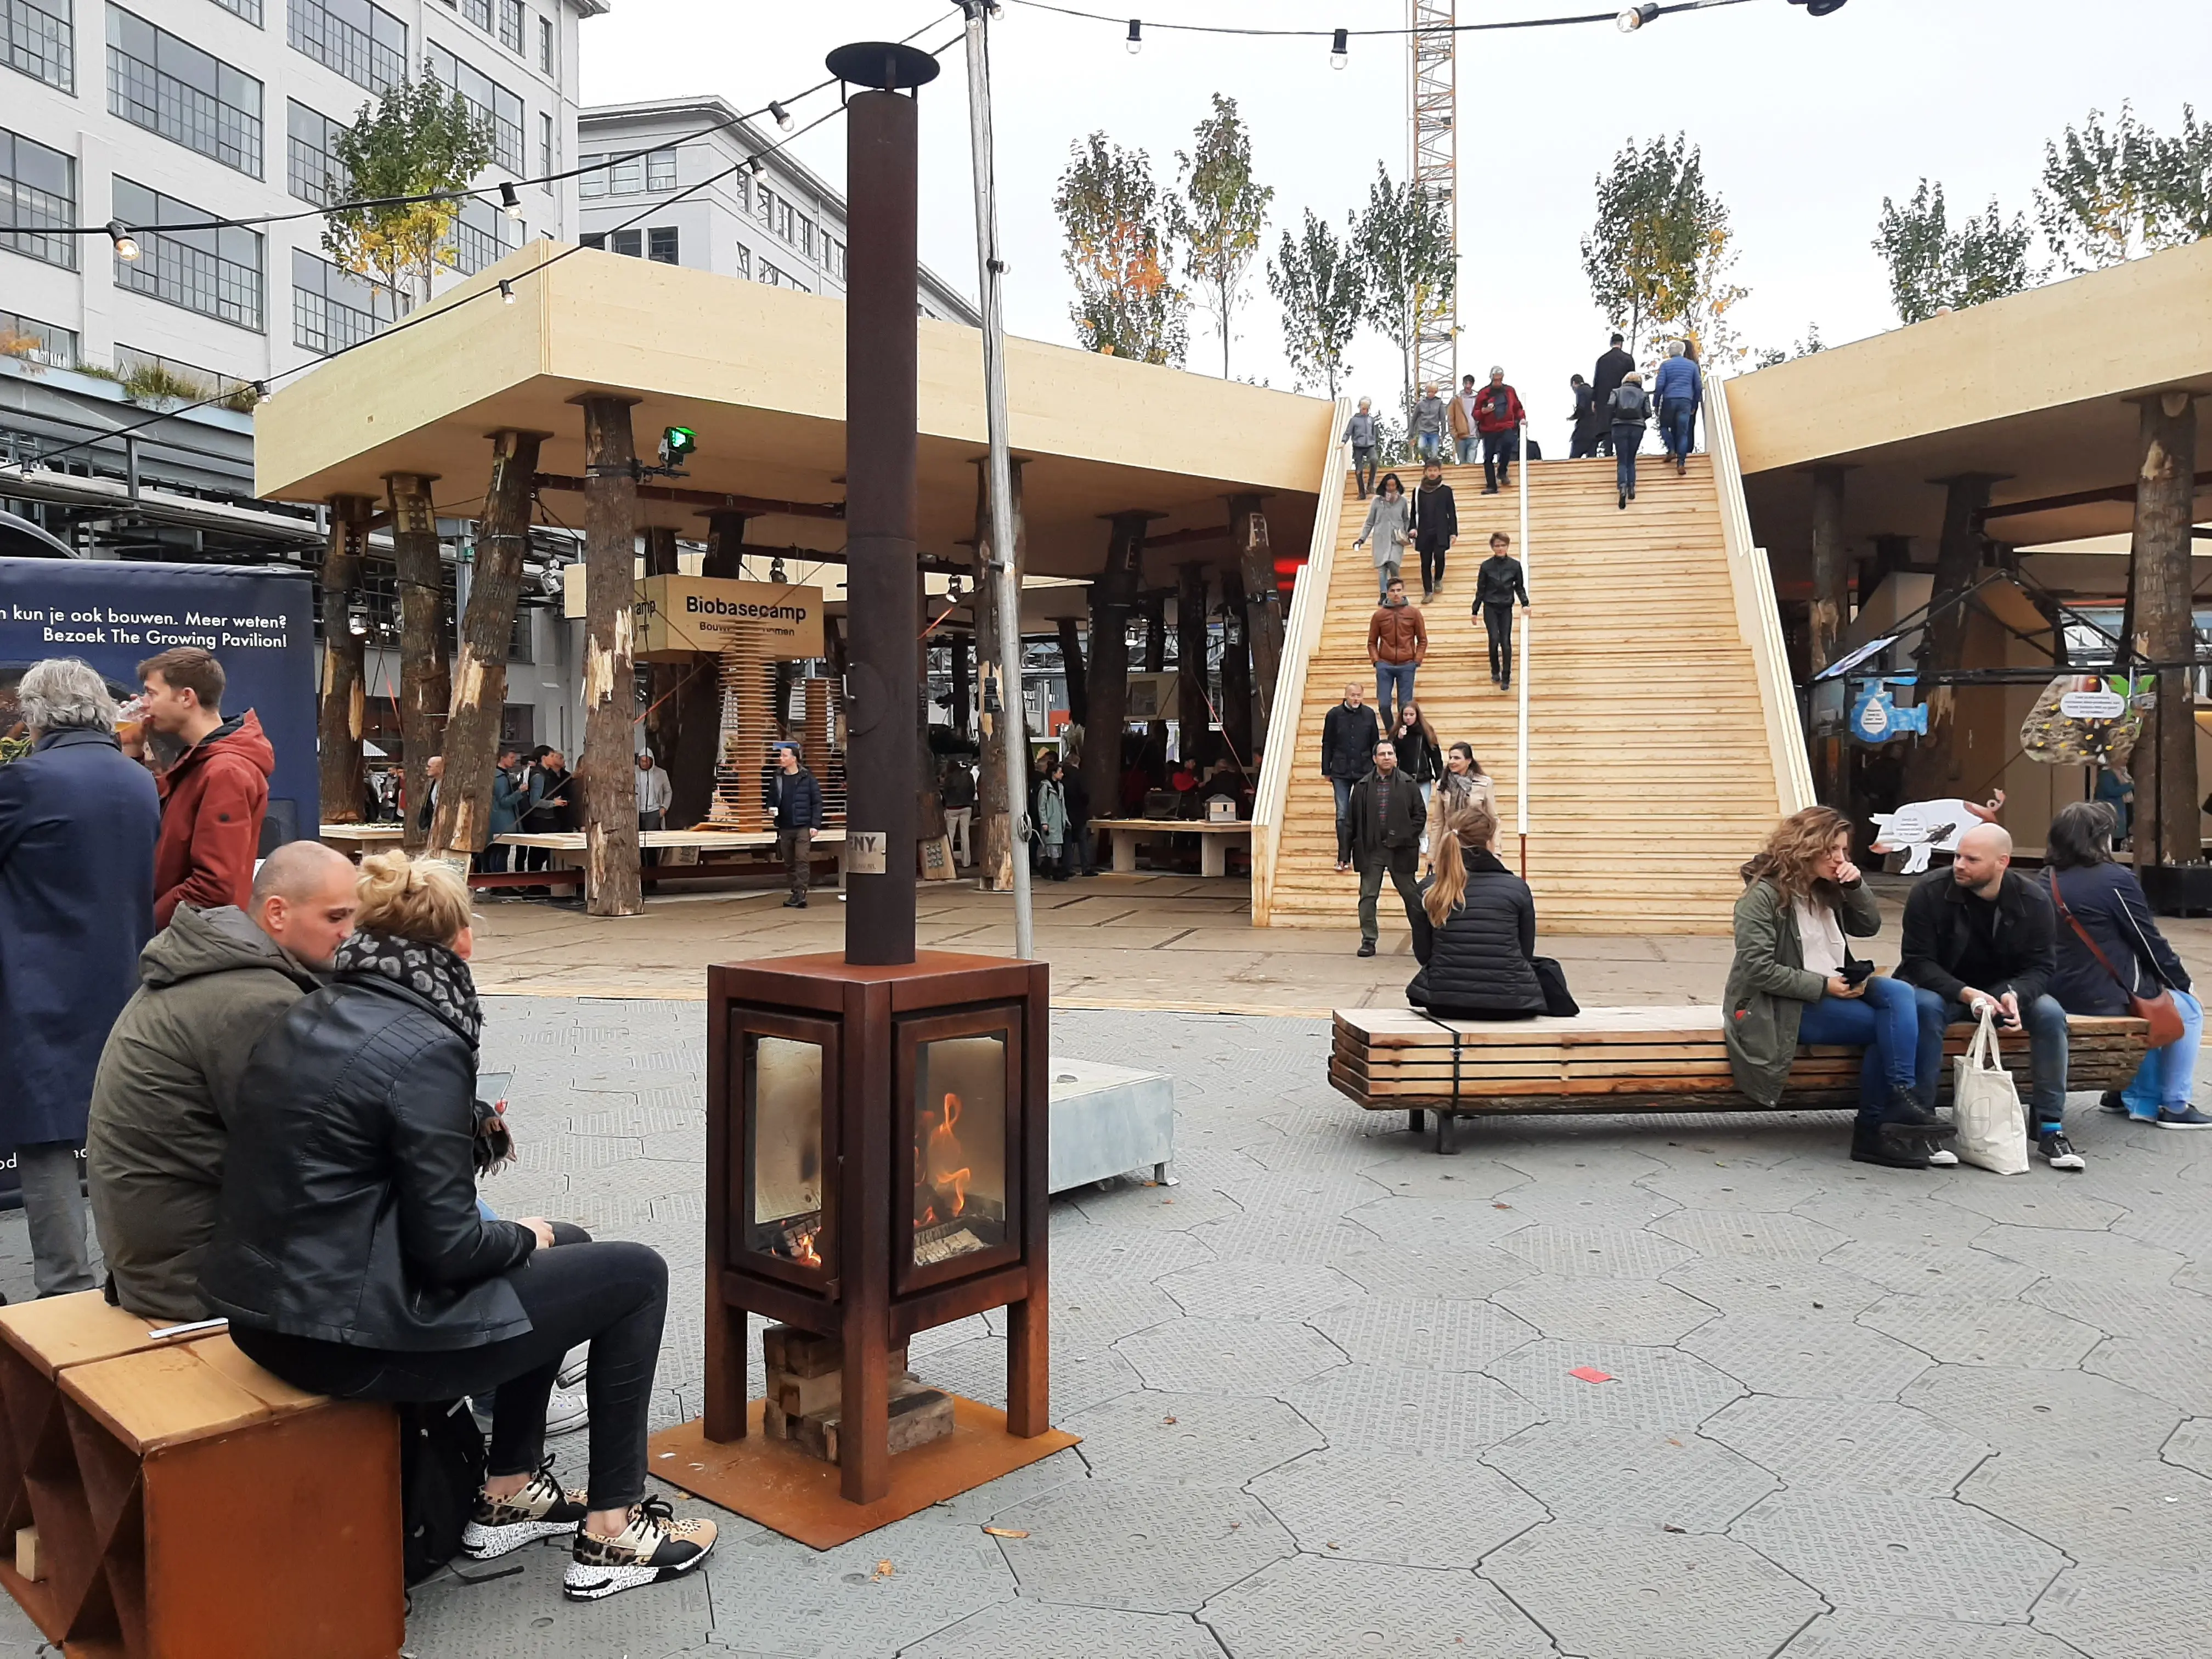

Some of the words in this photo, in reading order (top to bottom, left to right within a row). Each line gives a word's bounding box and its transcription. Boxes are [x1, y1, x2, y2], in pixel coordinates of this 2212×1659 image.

[13, 604, 43, 620] kun
[49, 607, 65, 625] je
[71, 607, 103, 623] ook
[108, 607, 179, 625] bouwen.
[185, 611, 228, 627] Meer
[233, 615, 287, 629] weten?
[686, 596, 806, 624] Biobasecamp
[43, 627, 106, 643] Bezoek
[111, 628, 140, 644] The
[146, 630, 217, 650] Growing
